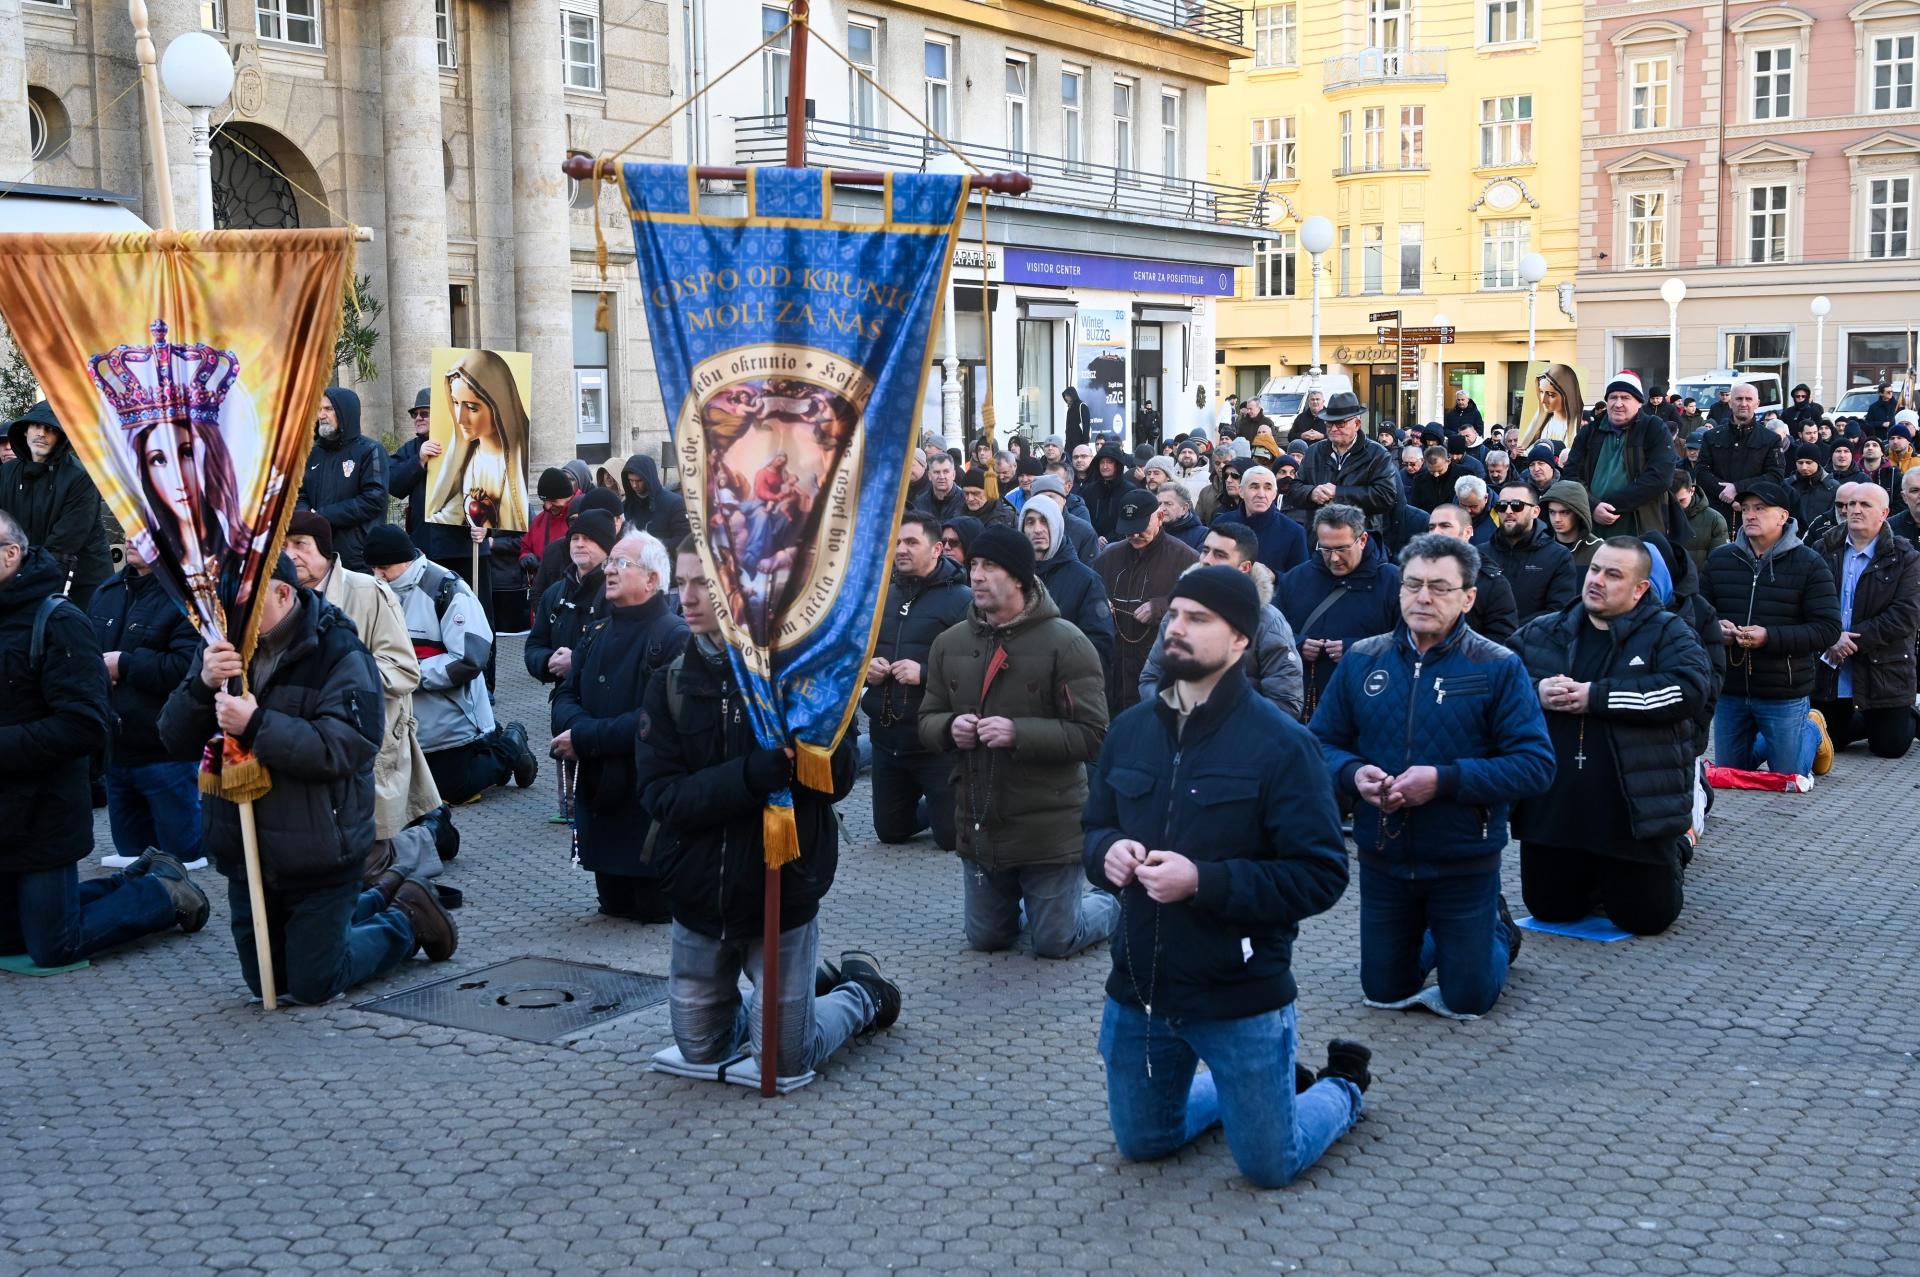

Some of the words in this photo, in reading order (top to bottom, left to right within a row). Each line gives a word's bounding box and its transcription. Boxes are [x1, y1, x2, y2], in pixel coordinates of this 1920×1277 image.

[1026, 262, 1054, 274] VISITOR
[1056, 265, 1081, 276] CENTER
[1133, 271, 1156, 281] CENTAR
[1157, 273, 1166, 282] ZA
[1167, 273, 1204, 285] POSJETITELJE
[748, 265, 791, 288] OD
[803, 268, 909, 314] KRUNIC
[688, 302, 764, 333] MOLI
[776, 301, 815, 326] ZA
[826, 307, 884, 340] NAS
[1081, 316, 1104, 329] Winter
[1086, 329, 1111, 341] BUZZG
[731, 353, 797, 375] okrunio
[818, 362, 861, 391] Koji
[828, 527, 847, 553] bio
[800, 576, 835, 625] začela
